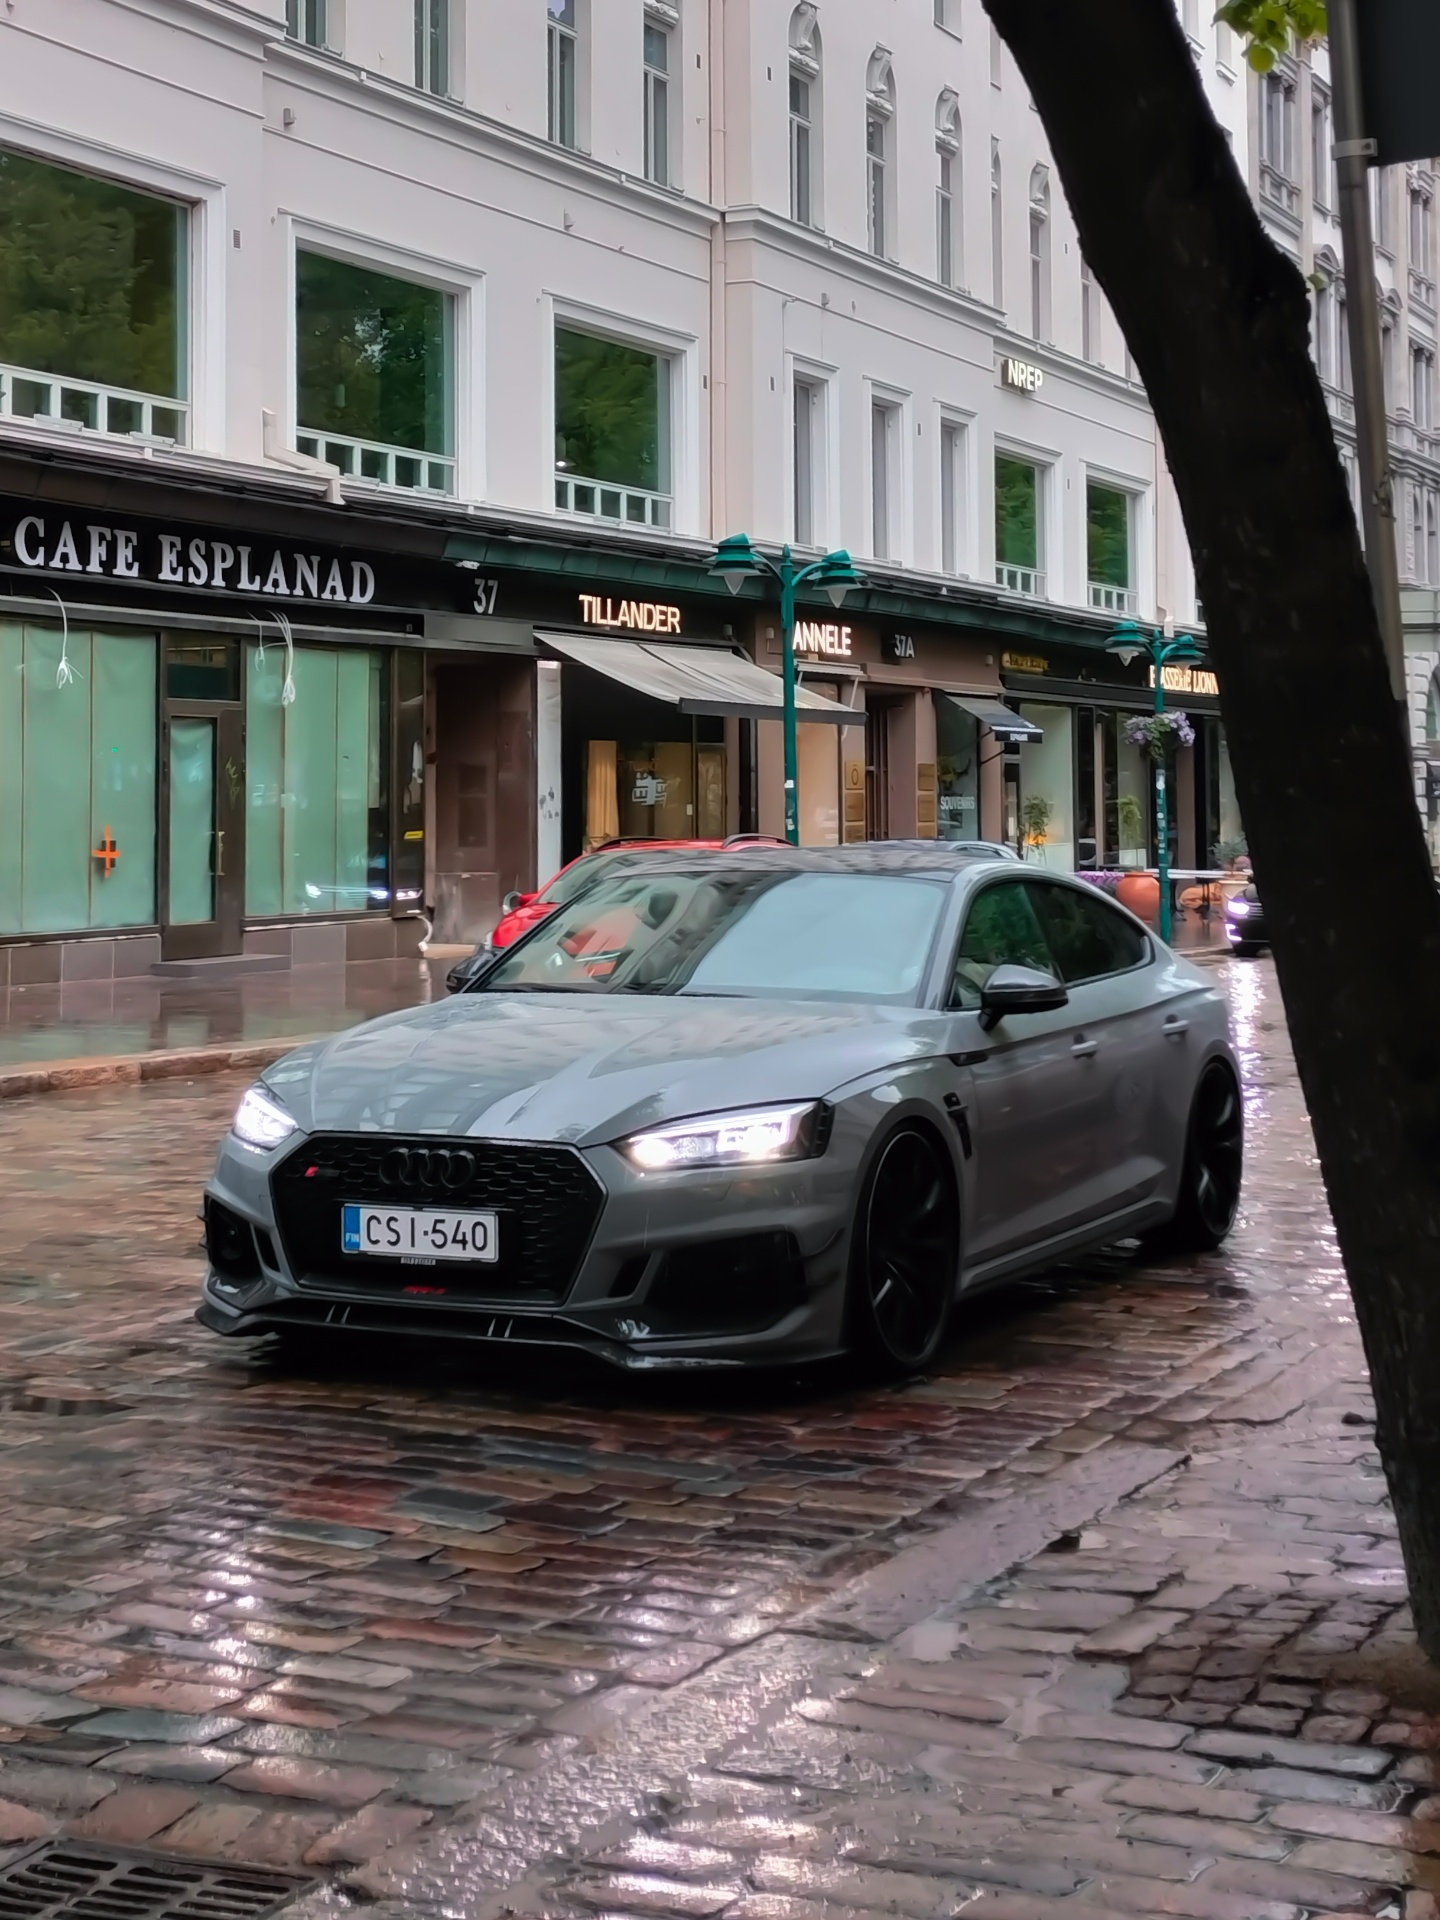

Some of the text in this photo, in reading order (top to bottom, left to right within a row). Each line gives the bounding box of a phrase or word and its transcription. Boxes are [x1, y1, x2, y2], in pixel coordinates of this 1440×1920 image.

[1008, 358, 1044, 391] NREP
[14, 516, 376, 604] CAFE ESPLANAD
[473, 578, 499, 615] 37
[578, 594, 681, 634] TILLANDER
[894, 633, 915, 658] 37A
[366, 1214, 488, 1252] CSI-540
